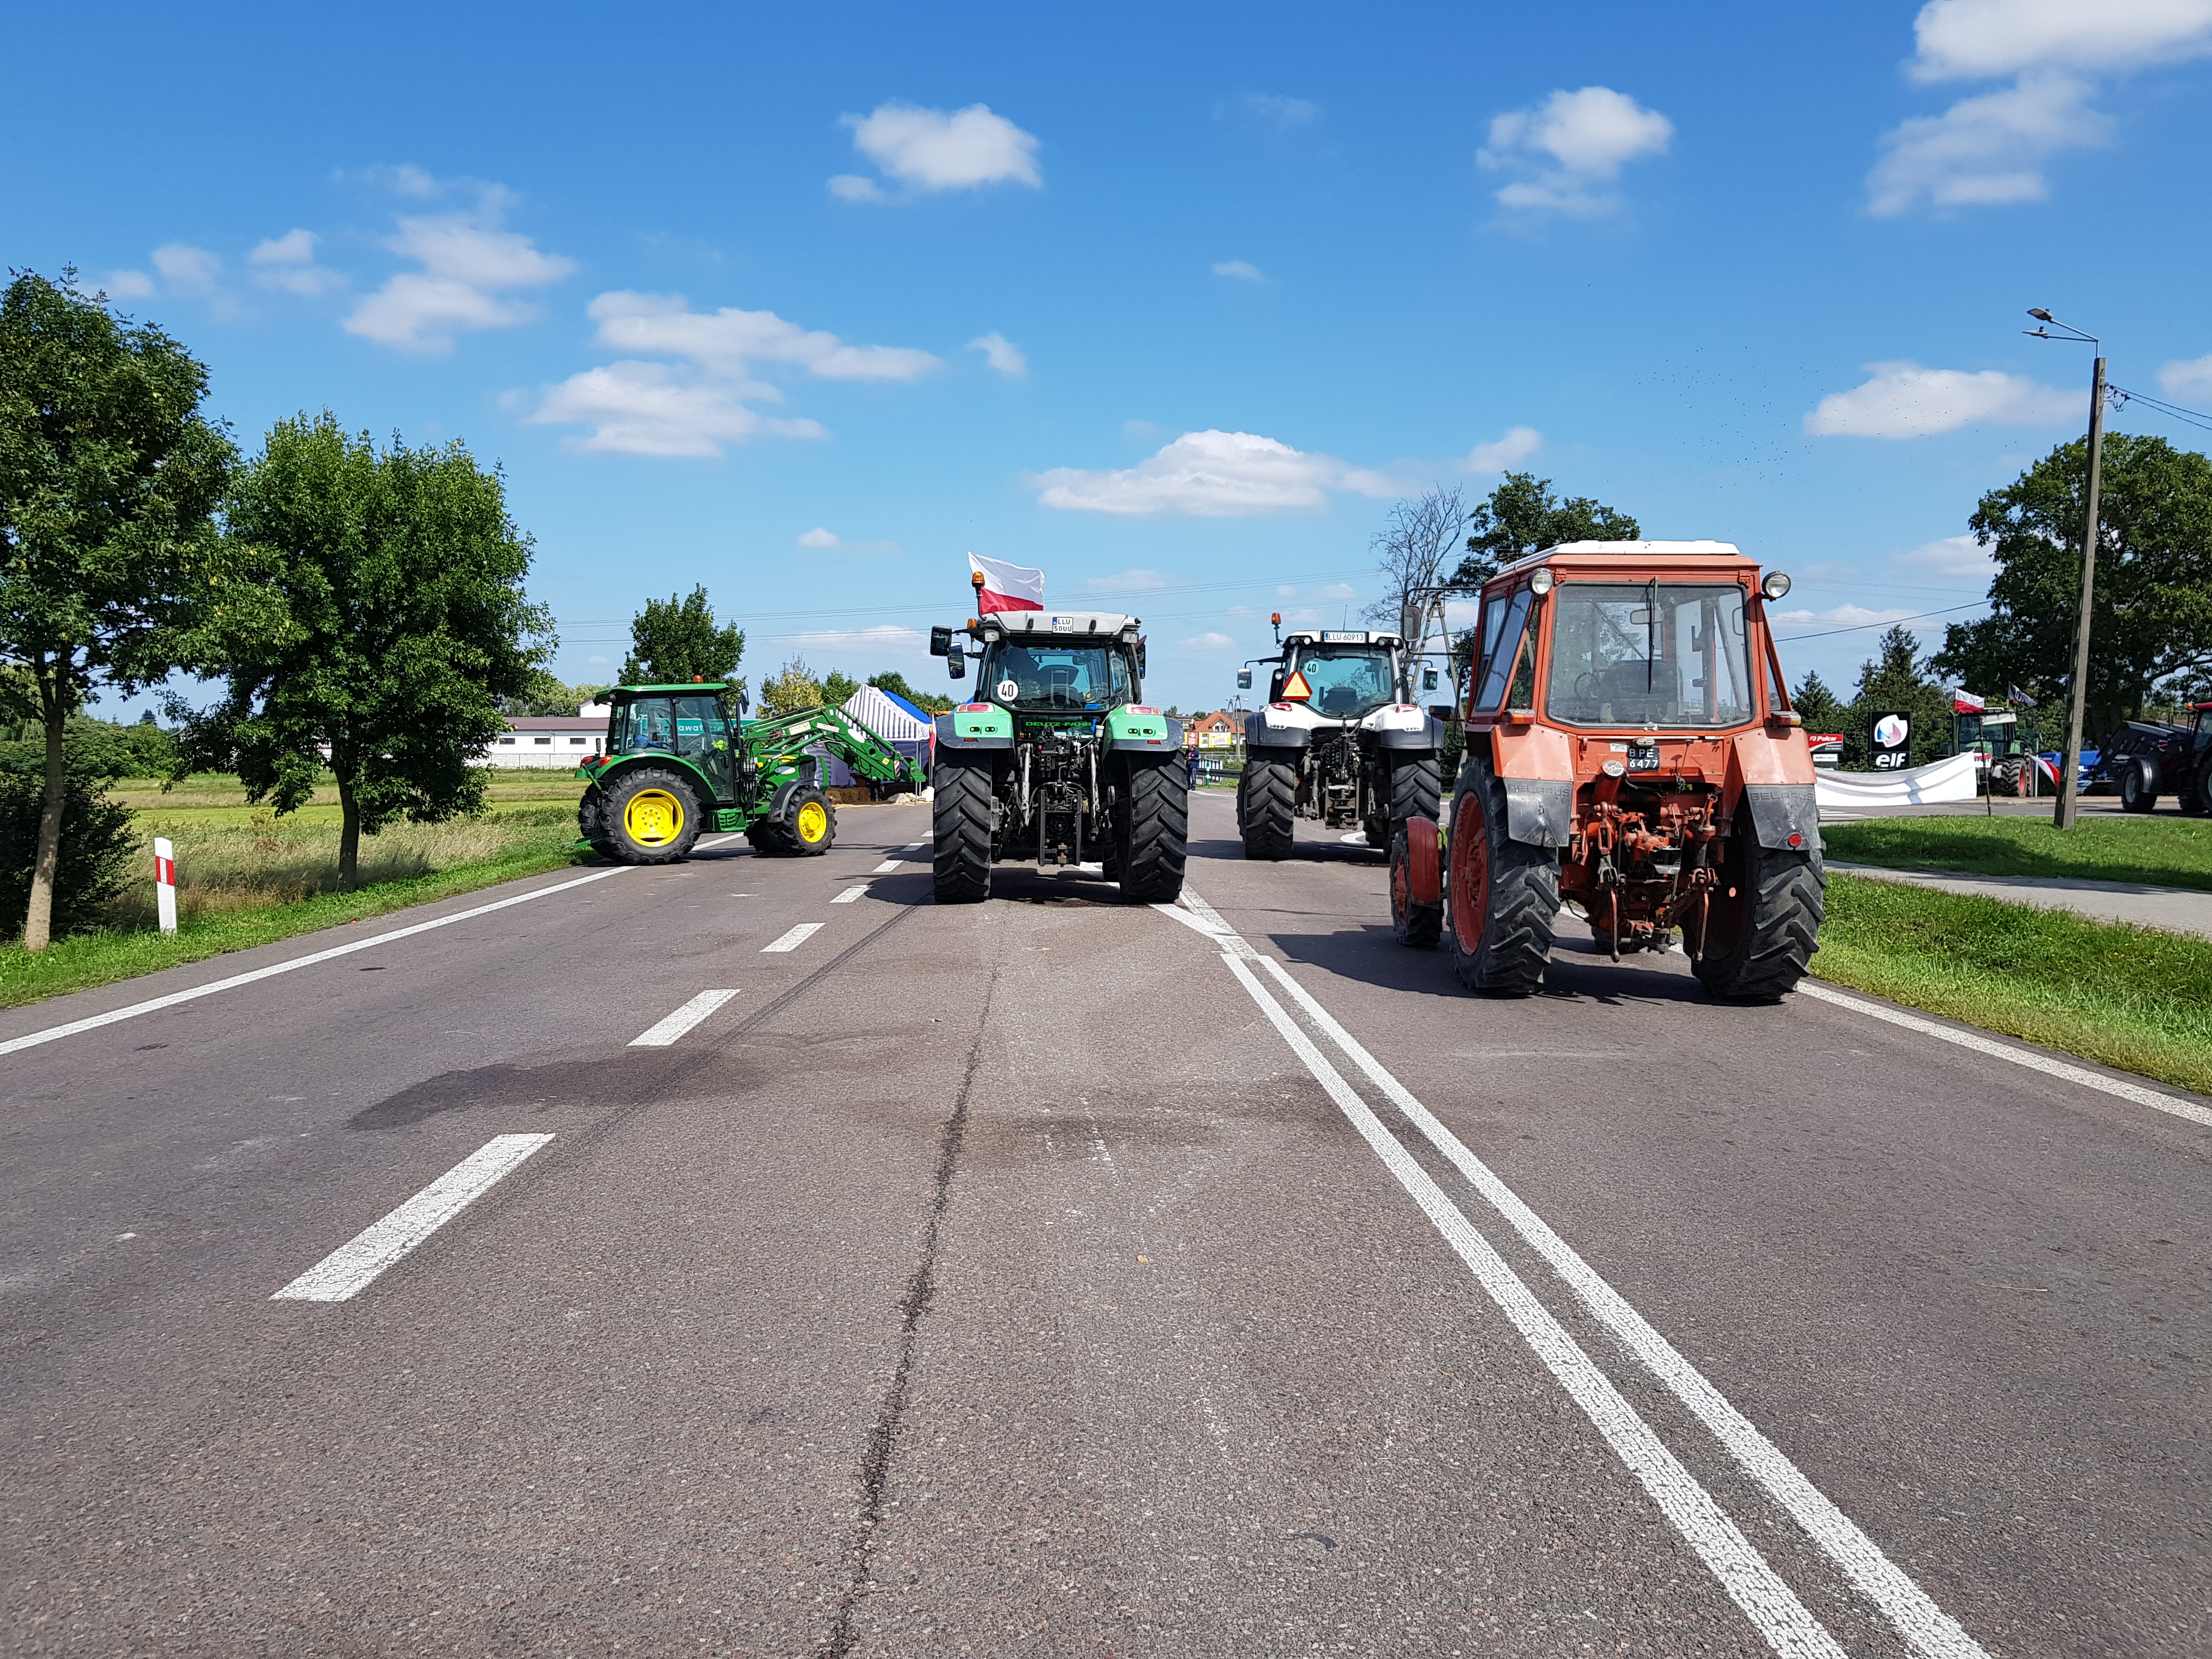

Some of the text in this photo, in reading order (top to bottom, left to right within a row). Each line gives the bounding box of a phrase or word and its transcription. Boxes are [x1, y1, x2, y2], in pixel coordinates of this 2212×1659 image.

[1307, 663, 1317, 673] 40
[1001, 684, 1014, 697] 40
[1629, 759, 1658, 769] 6477
[1876, 753, 1906, 768] elf
[1507, 784, 1570, 797] BELARUS
[1750, 792, 1814, 801] BELARUS
